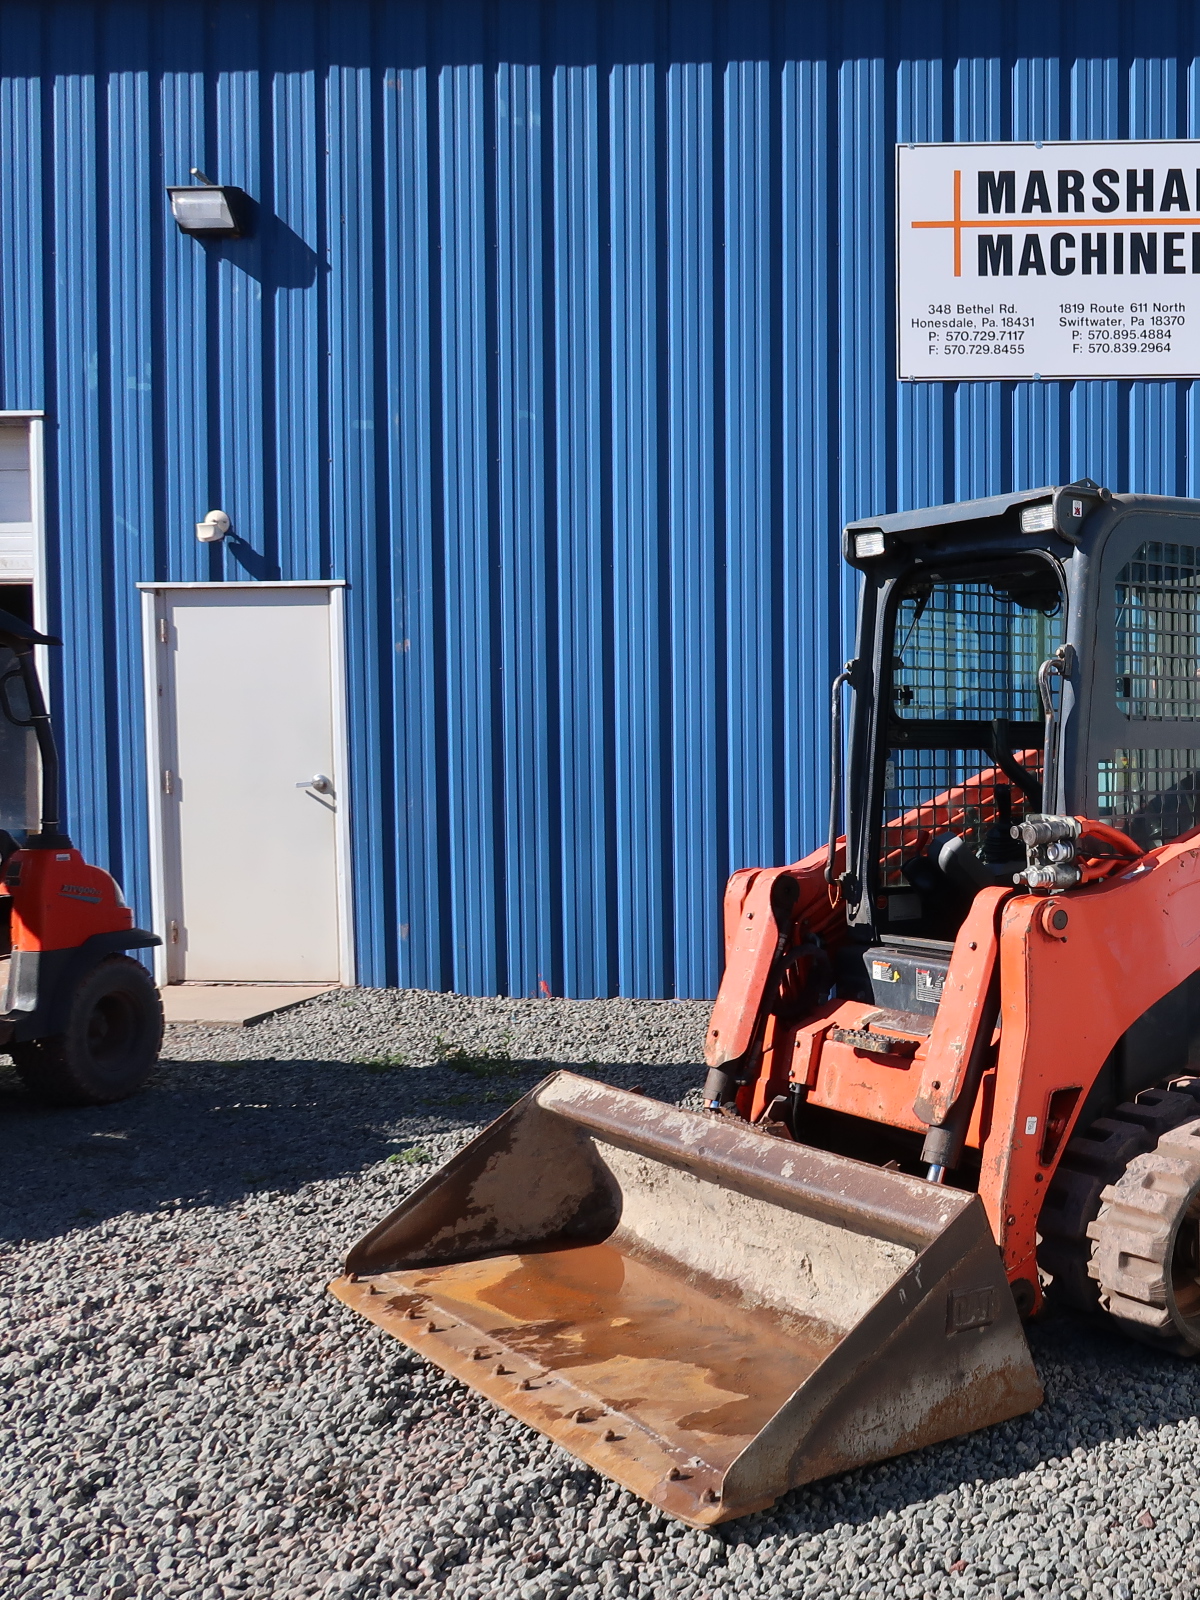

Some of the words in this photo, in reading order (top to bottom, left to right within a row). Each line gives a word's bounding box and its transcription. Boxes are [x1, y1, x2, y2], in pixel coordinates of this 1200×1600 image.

[927, 303, 952, 315] 348
[956, 303, 994, 315] Bethel
[999, 303, 1018, 314] Rd.
[1058, 302, 1085, 314] 1819
[1089, 303, 1125, 314] Route
[1129, 302, 1148, 313] 611
[1152, 302, 1186, 313] North
[910, 317, 977, 329] Honesdale,
[981, 317, 999, 328] Pa.
[1000, 316, 1035, 328] 18431
[1058, 316, 1126, 328] Swiftwater,
[1130, 315, 1145, 327] Pa
[1149, 315, 1186, 327] 18370
[928, 331, 940, 342] P:
[945, 330, 1025, 342] 570.729.7117
[1071, 329, 1083, 341] P:
[1087, 328, 1172, 341] 570.895.4884
[928, 344, 939, 355] F:
[943, 343, 1025, 355] 570.729.8455
[1072, 343, 1083, 354] F:
[1088, 342, 1172, 354] 570.839.2964
